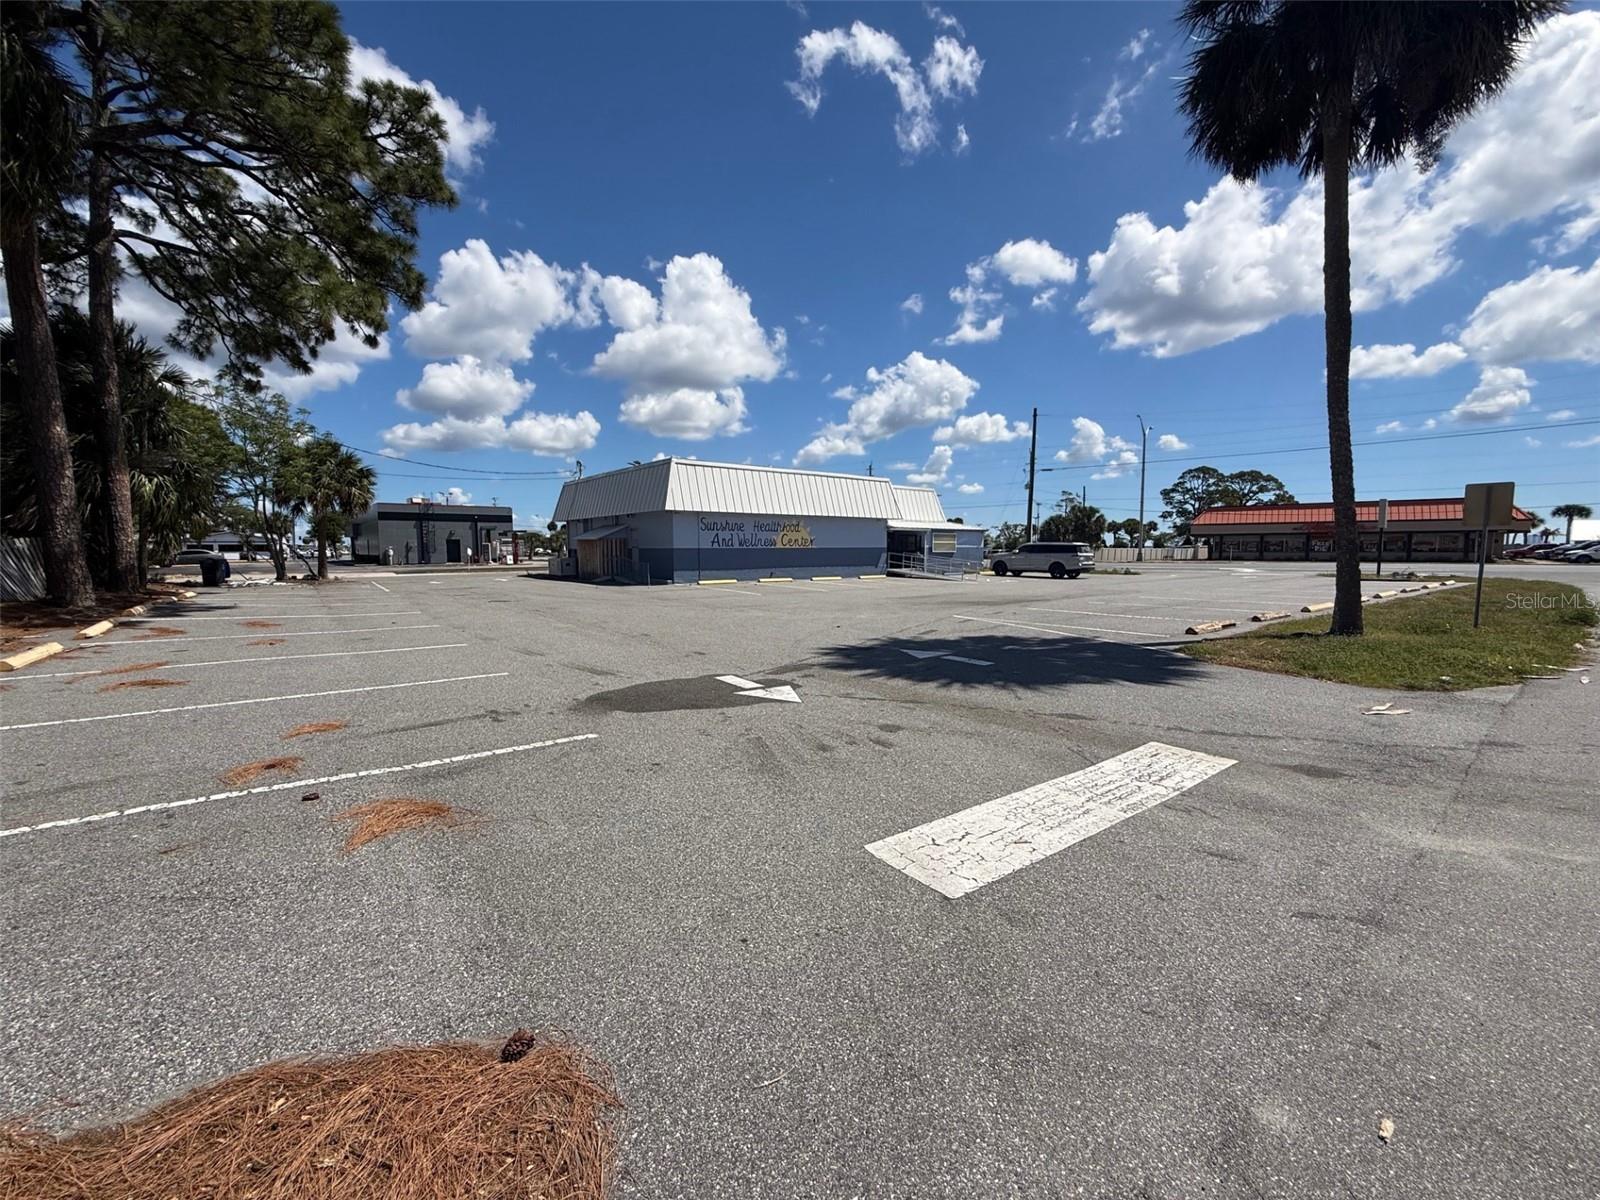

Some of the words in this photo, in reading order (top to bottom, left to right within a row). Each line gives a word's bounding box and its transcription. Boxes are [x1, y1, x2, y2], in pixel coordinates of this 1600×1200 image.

[700, 516, 745, 532] Sunshine
[753, 519, 801, 533] Healthfood
[711, 533, 734, 548] And
[737, 534, 777, 548] Wellness
[781, 533, 816, 548] Center
